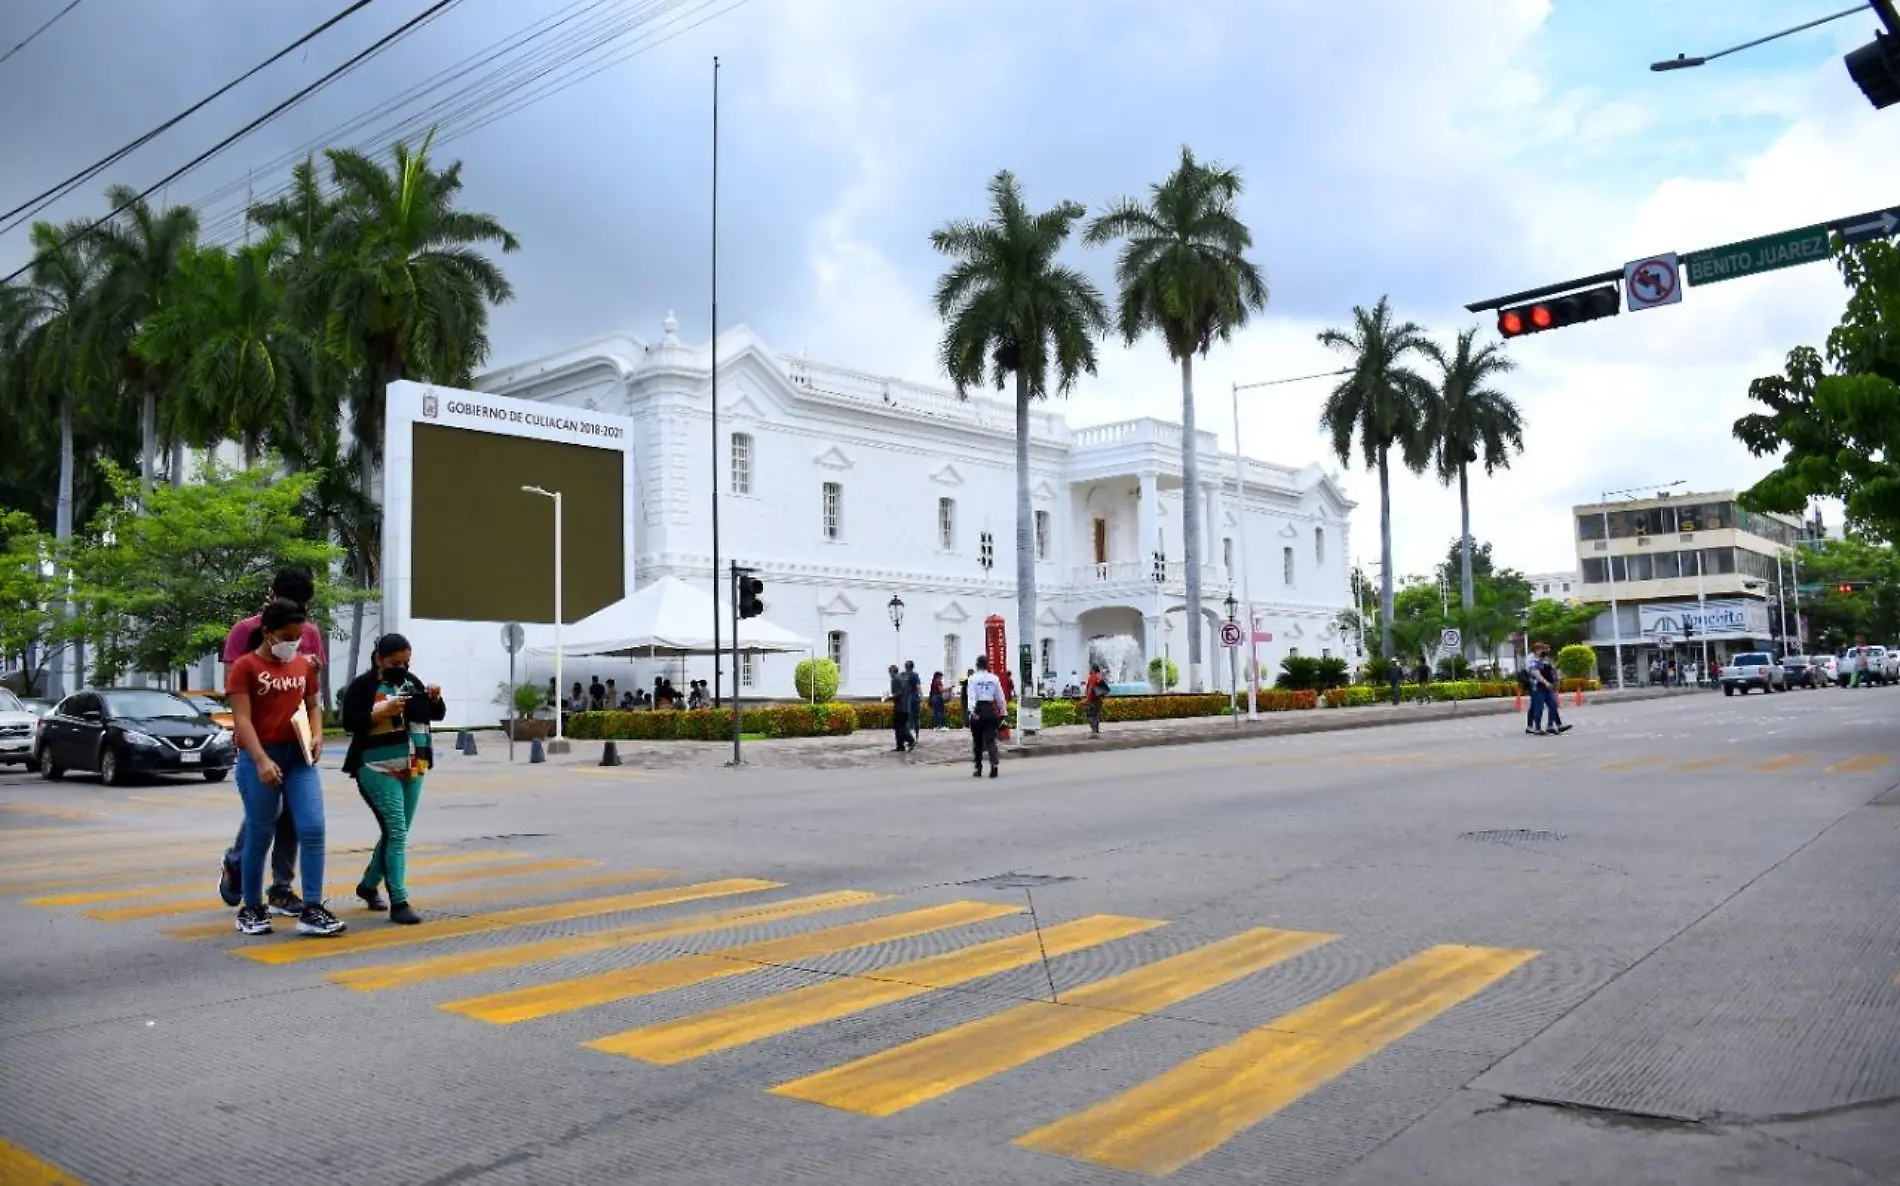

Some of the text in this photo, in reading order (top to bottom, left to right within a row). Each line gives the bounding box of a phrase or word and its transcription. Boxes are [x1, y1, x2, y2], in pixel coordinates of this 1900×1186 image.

[1692, 236, 1824, 280] BENITO JUAREZ
[447, 401, 507, 421] GOBIERNO
[510, 410, 522, 422] DE
[580, 421, 623, 438] 2018-2021
